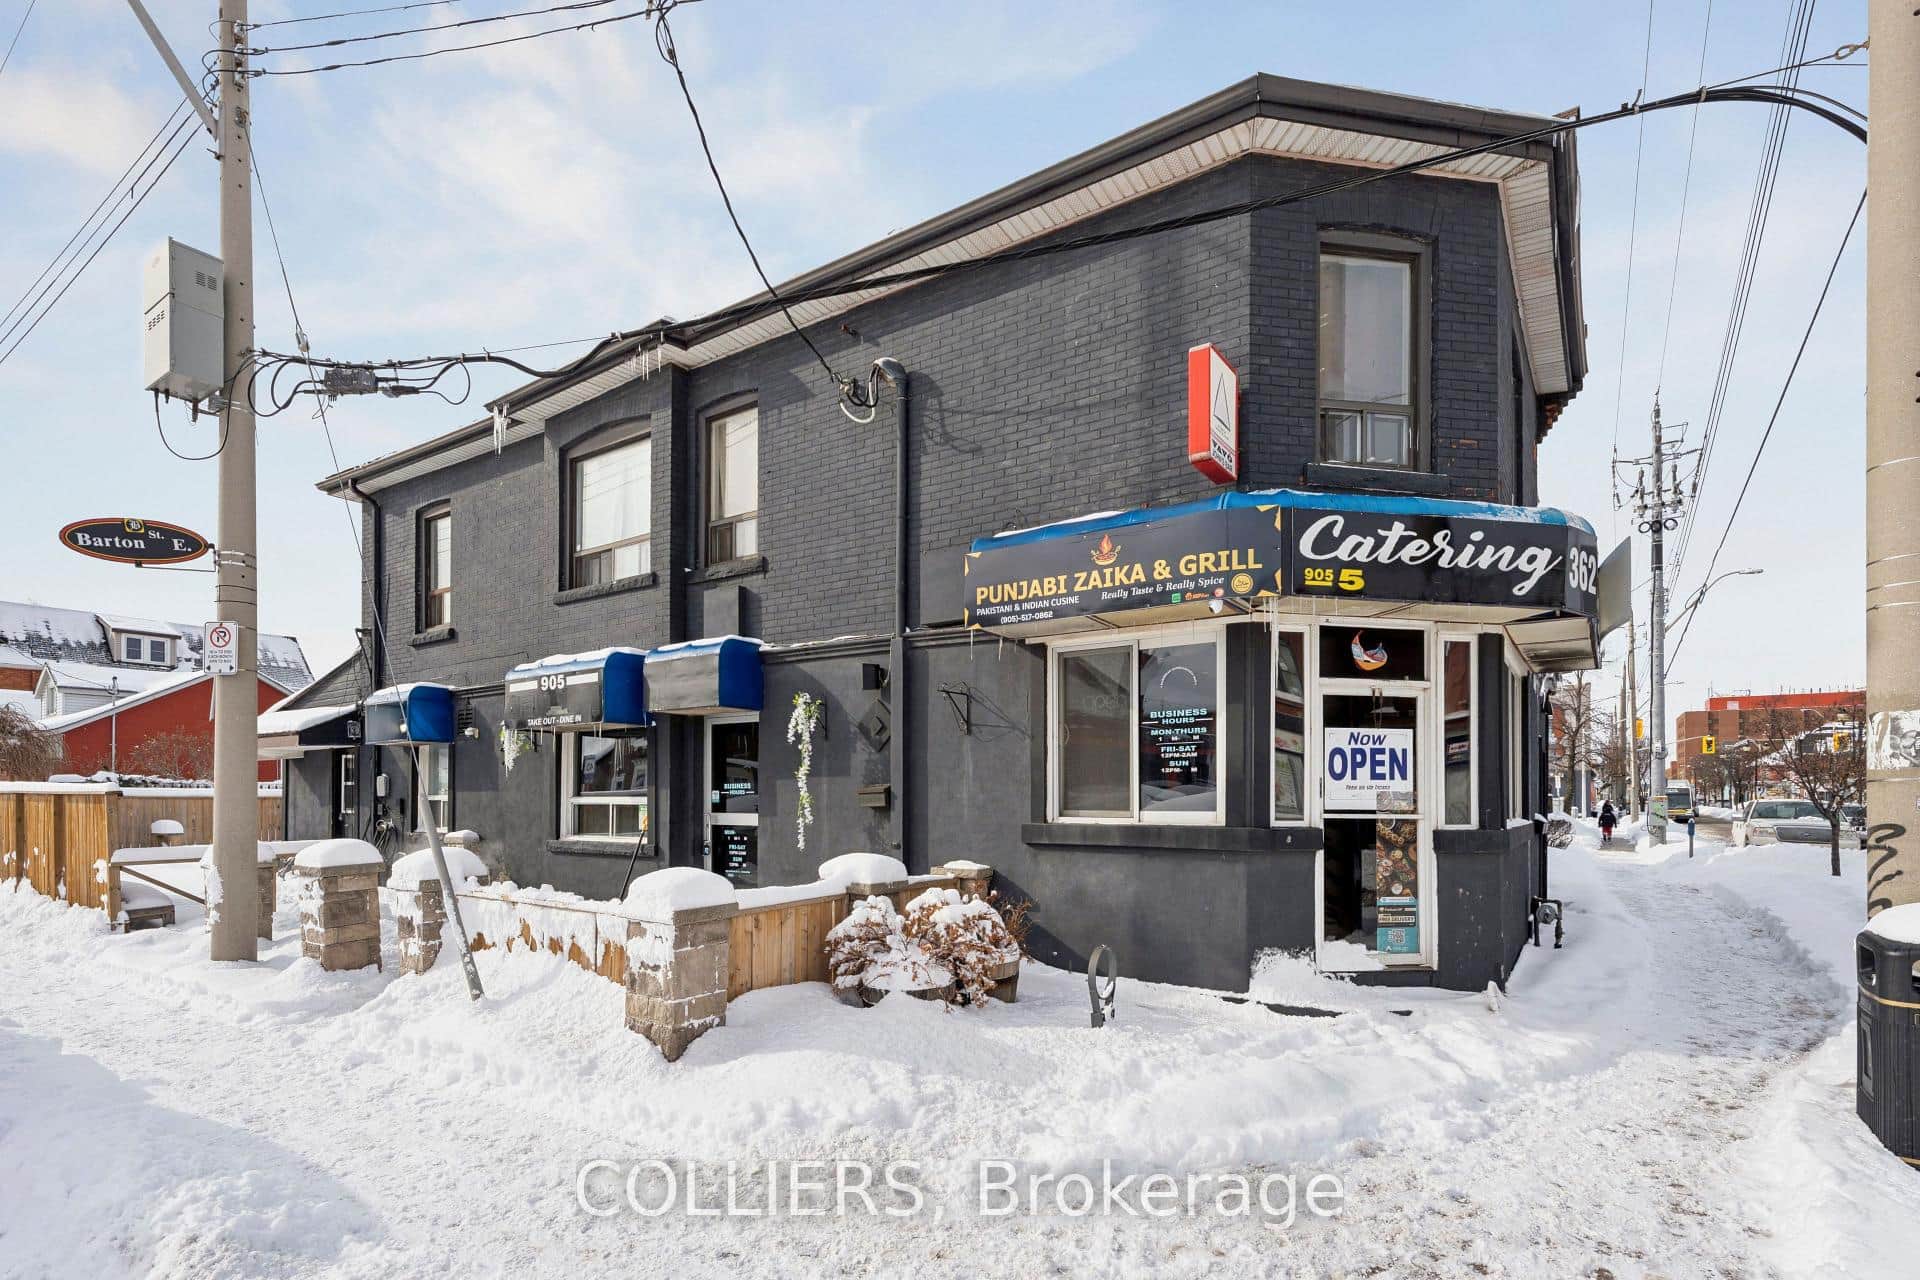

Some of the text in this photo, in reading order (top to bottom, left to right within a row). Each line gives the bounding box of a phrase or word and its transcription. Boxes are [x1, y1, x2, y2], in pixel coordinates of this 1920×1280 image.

[75, 530, 192, 552] Barton St. E.
[1299, 514, 1562, 596] Catering
[976, 548, 1263, 605] PUNJABI ZAIKA & GRILL
[1304, 567, 1333, 582] 905
[1569, 546, 1597, 595] 362
[1101, 590, 1129, 600] Really
[1131, 586, 1153, 596] Taste
[1156, 584, 1164, 592] &
[1166, 580, 1195, 591] Really
[1198, 577, 1224, 588] Spice
[976, 595, 1080, 616] PAKISTANI & INDIAN CUSINE
[541, 674, 565, 691] 905
[528, 718, 542, 726] TAKE
[543, 716, 556, 725] OUT
[560, 715, 574, 723] DINE
[1150, 708, 1207, 719] BUSINESS
[1162, 717, 1195, 725] HOURS
[1151, 727, 1207, 736] MON-THURS
[1160, 745, 1197, 753] FRI-SAT
[1328, 747, 1408, 781] OPEN
